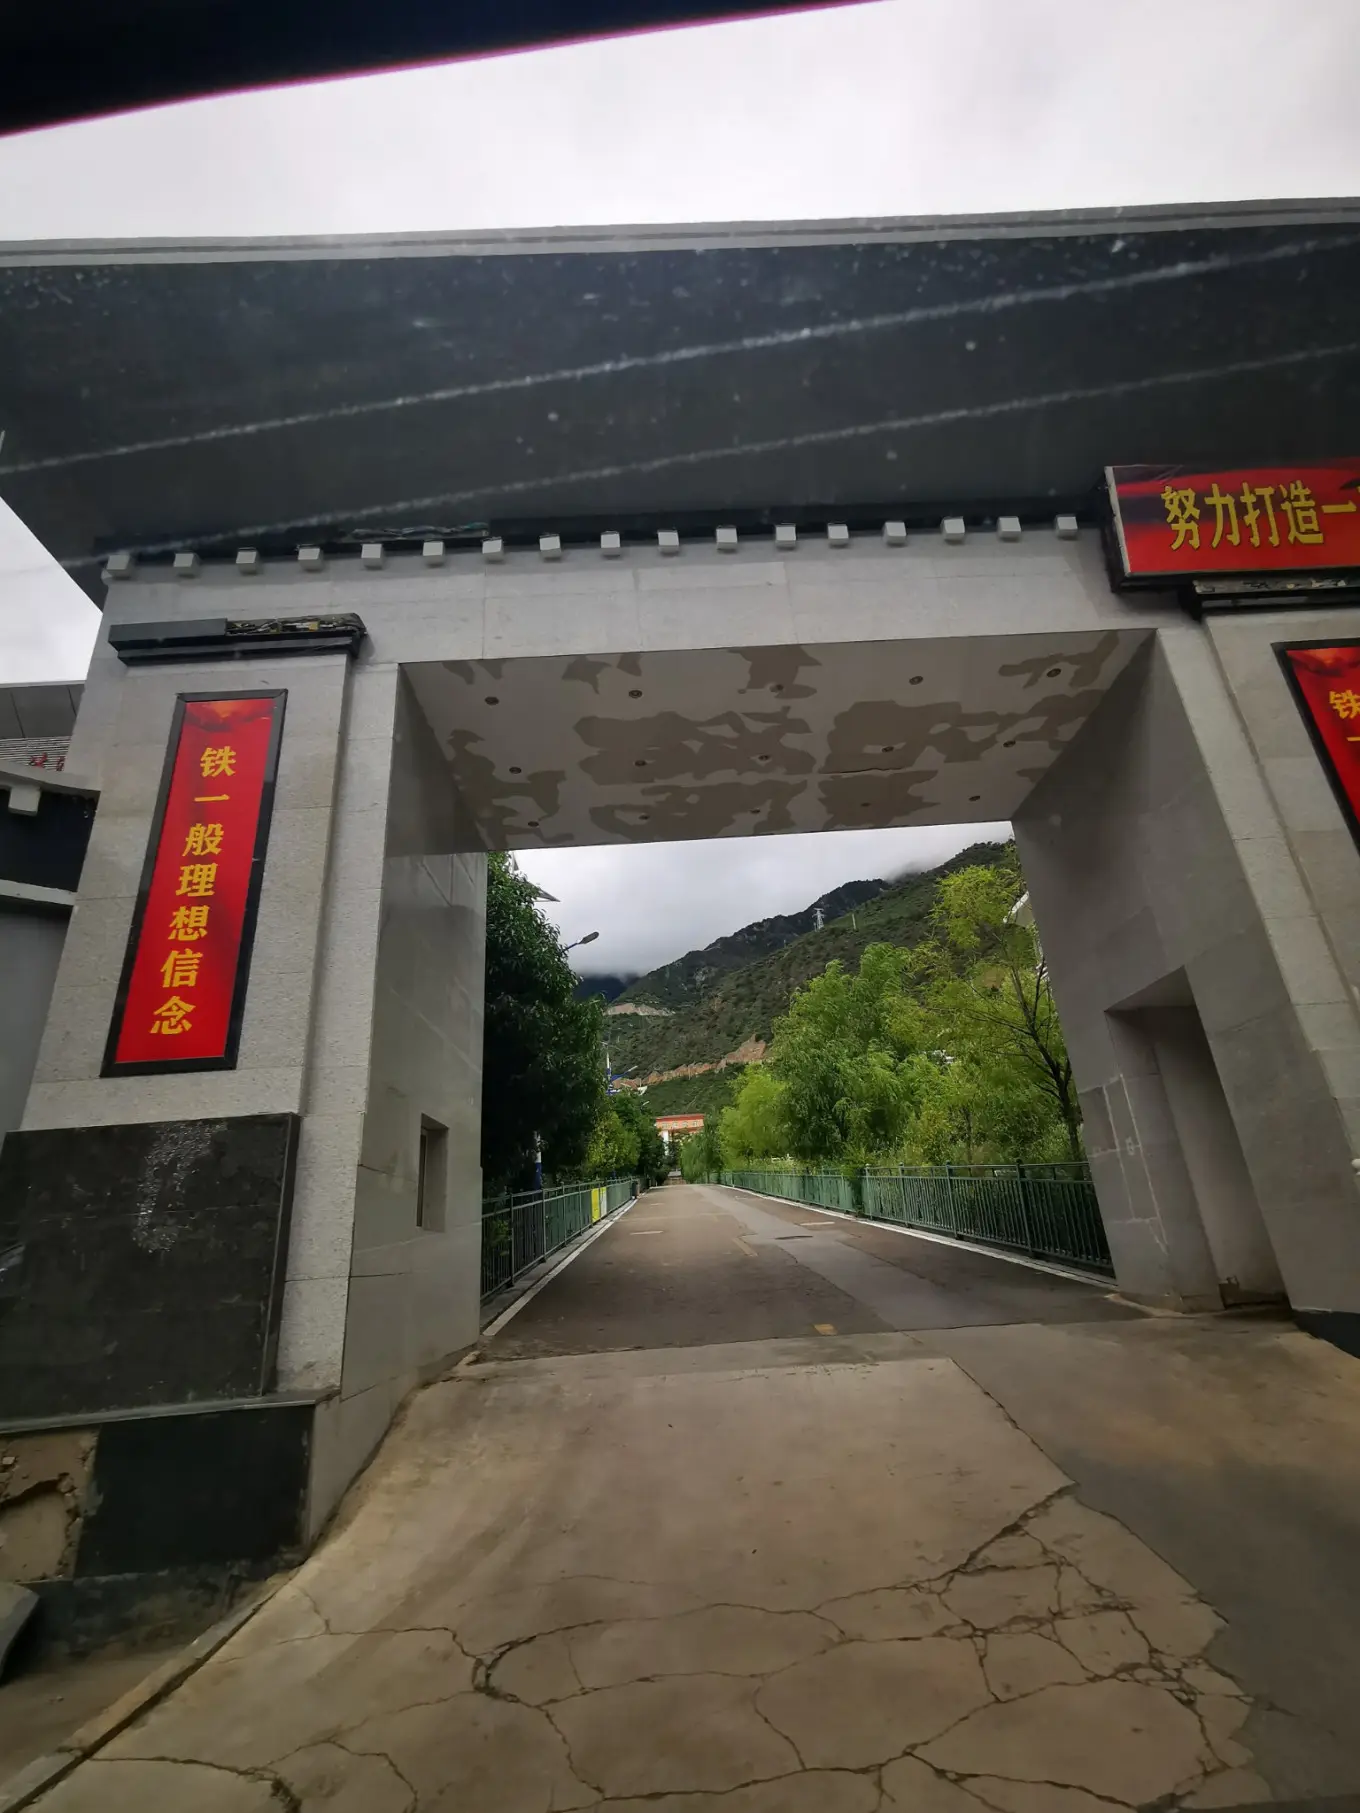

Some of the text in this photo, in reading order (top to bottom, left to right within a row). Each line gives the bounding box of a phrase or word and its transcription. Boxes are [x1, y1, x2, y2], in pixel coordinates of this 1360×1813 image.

[1160, 480, 1360, 551] 努力打造一
[149, 746, 236, 1035] 铁一般理想信念
